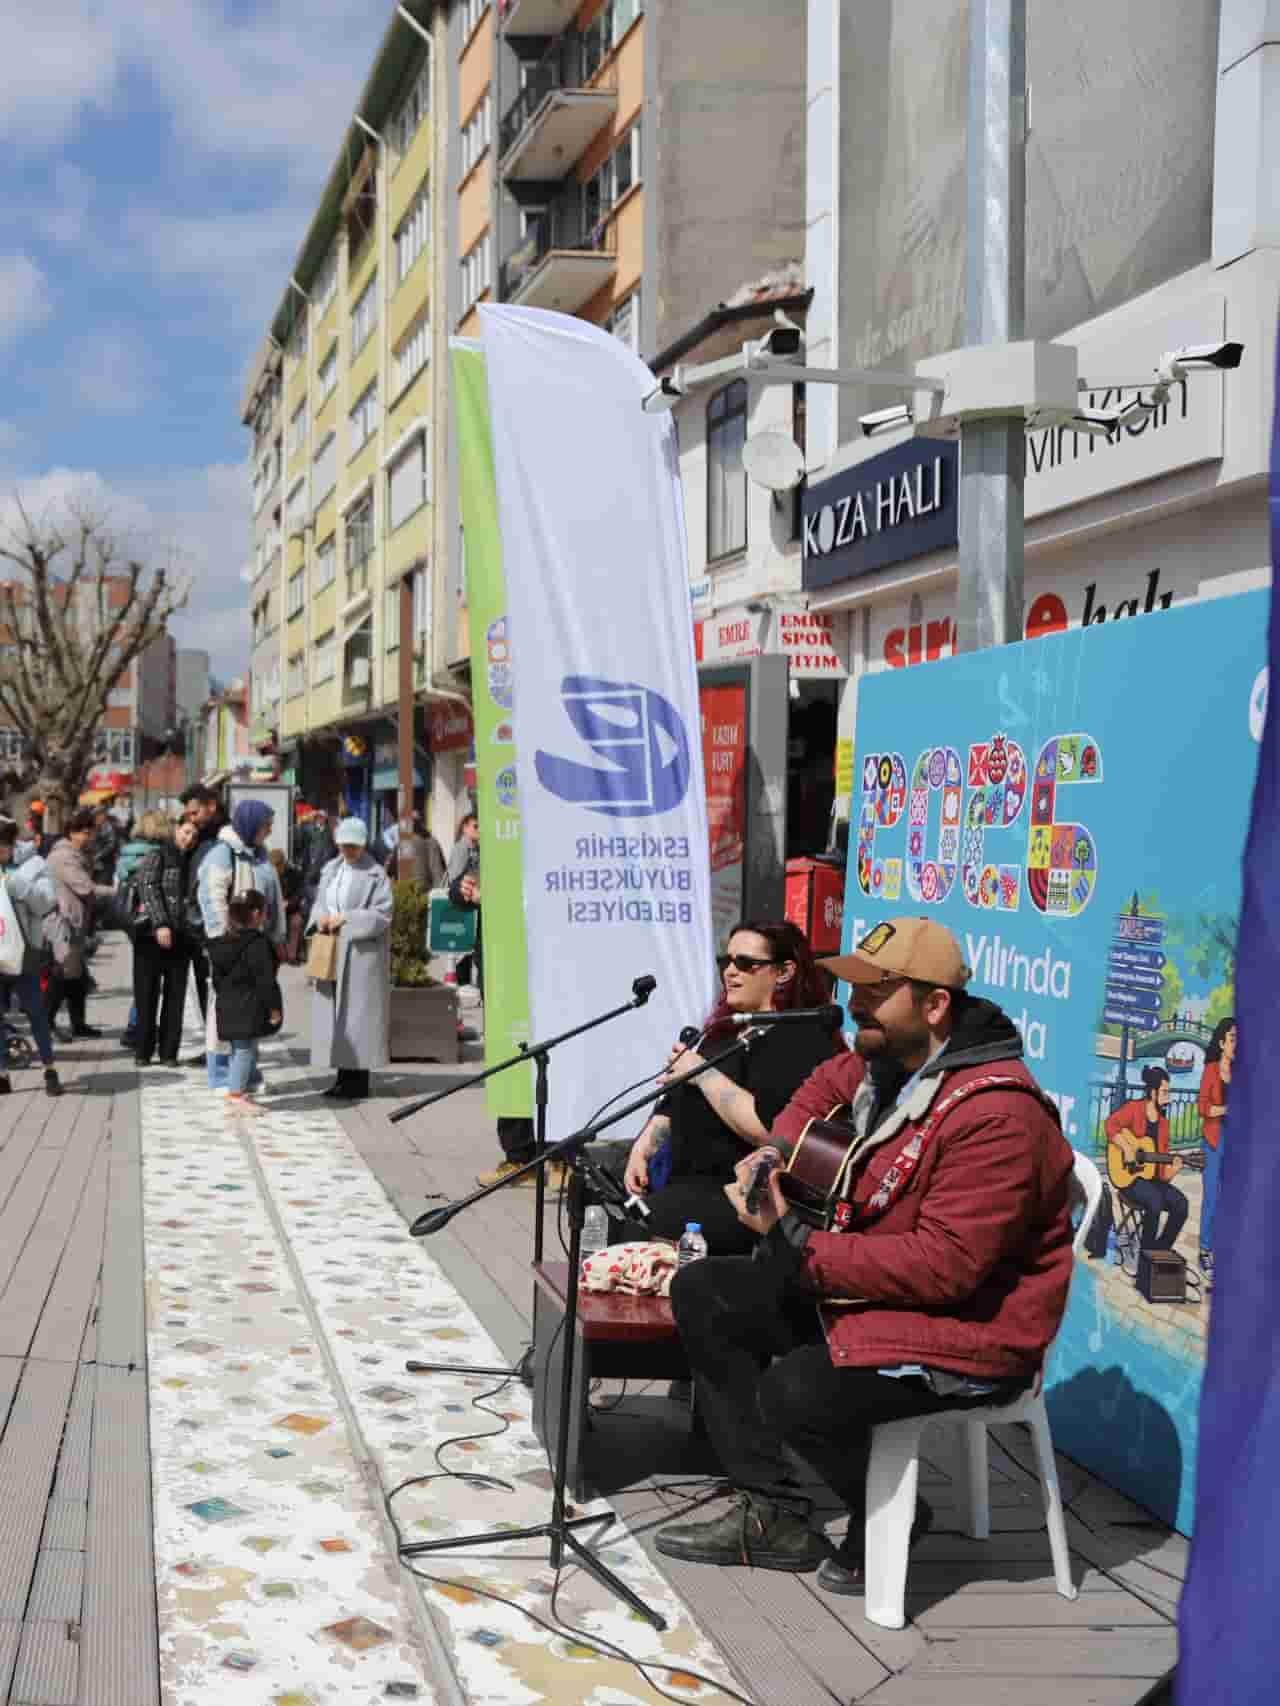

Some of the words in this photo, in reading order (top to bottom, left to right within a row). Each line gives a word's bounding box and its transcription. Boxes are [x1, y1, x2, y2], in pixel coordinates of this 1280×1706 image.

[803, 491, 868, 560] KOZA
[876, 456, 941, 533] HALI
[781, 614, 833, 629] EMRE
[782, 631, 833, 647] SPOR
